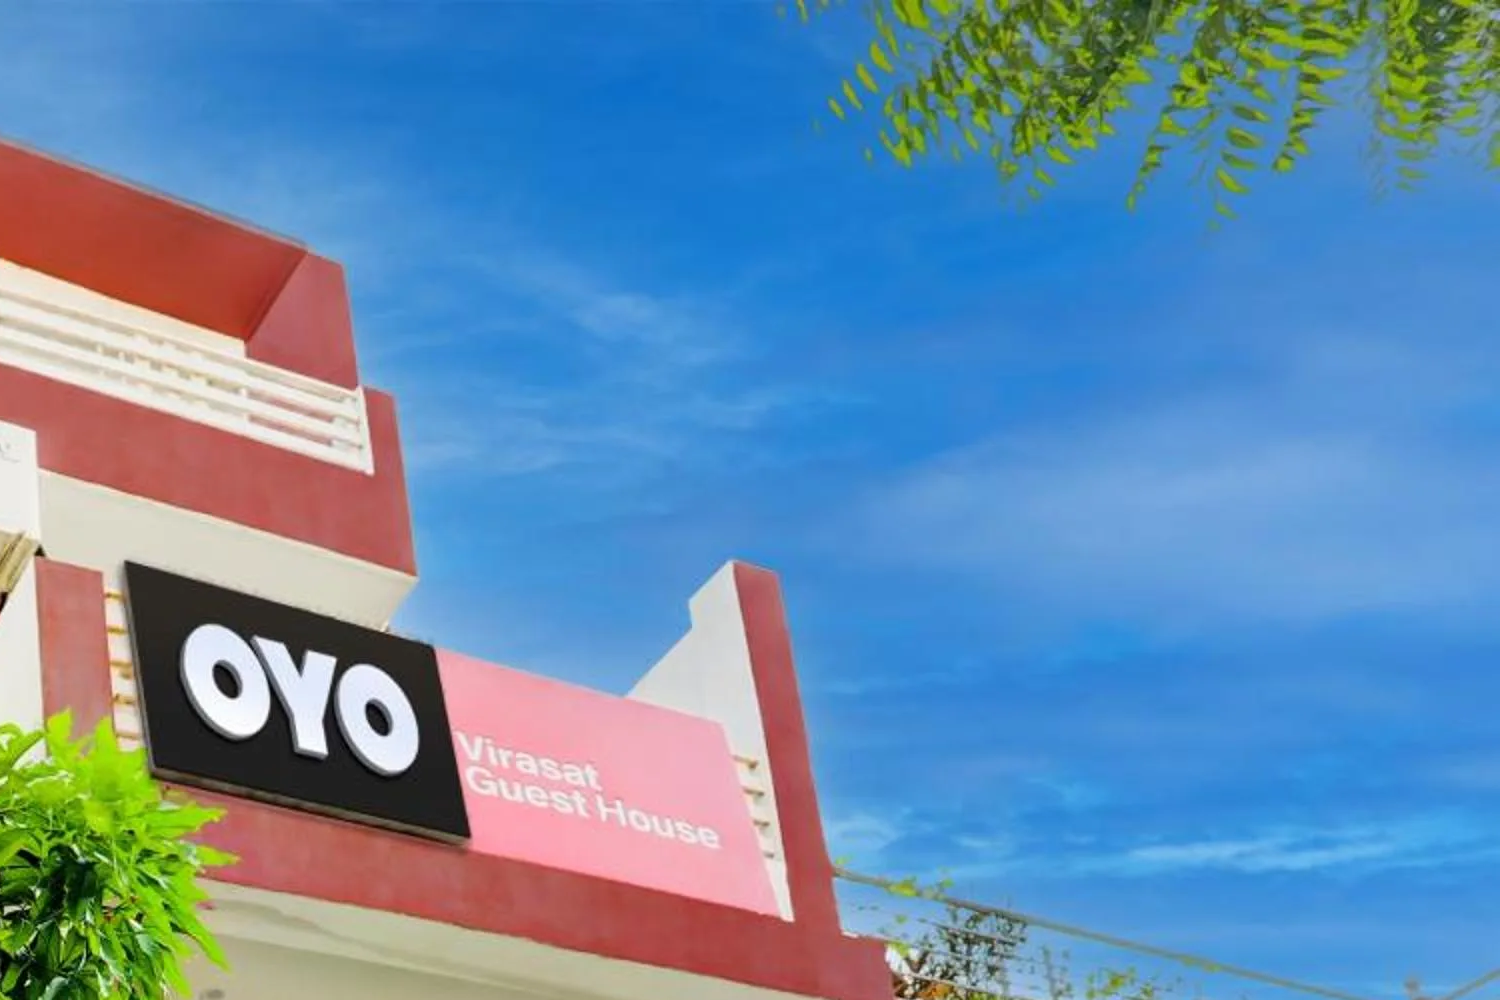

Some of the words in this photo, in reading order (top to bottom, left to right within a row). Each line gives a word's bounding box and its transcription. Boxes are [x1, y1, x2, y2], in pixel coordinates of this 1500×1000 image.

[180, 623, 419, 776] OYO
[452, 731, 602, 791] Virasat
[466, 765, 590, 818] Guest
[595, 793, 722, 849] House
